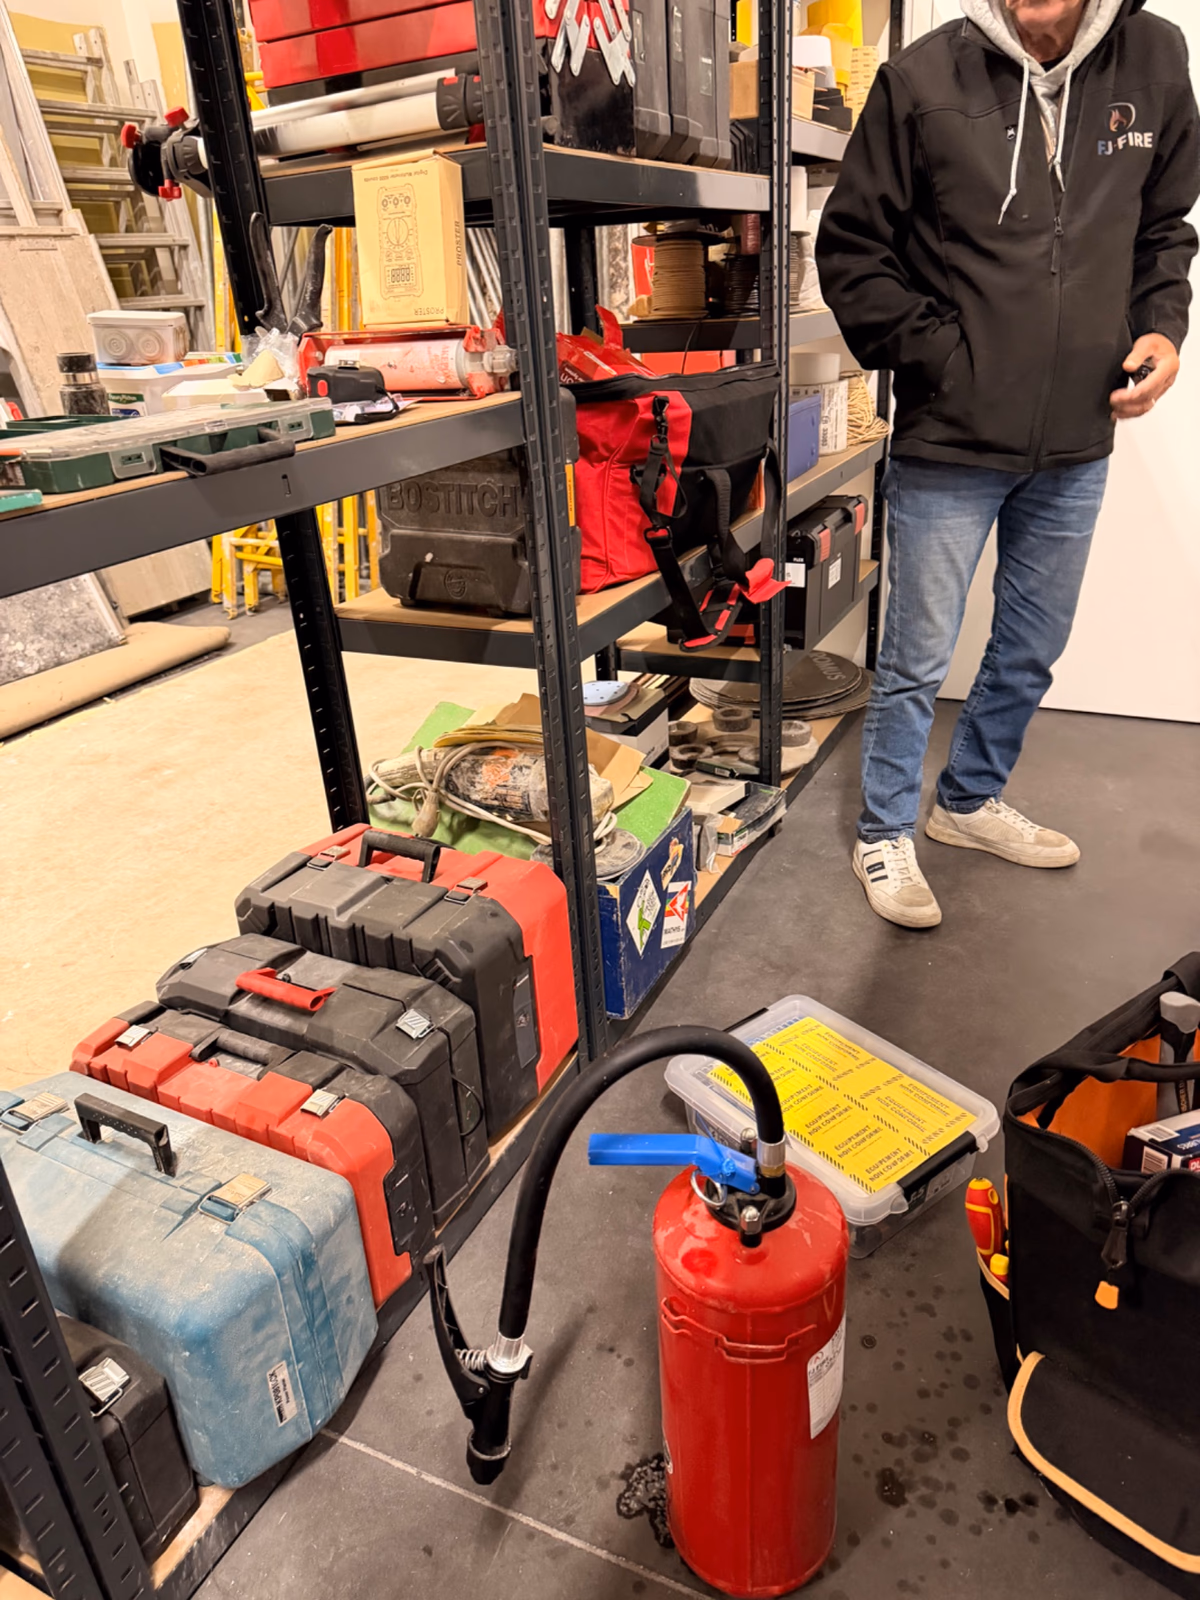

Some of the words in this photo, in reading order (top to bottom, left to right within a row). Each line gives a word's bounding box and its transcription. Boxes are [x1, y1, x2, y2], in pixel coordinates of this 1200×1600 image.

[454, 220, 463, 266] PROSTER
[413, 307, 445, 317] PROSTER
[387, 481, 519, 517] BOSTITCH
[899, 1083, 914, 1094] NON
[913, 1090, 950, 1117] CONFORME
[876, 1096, 891, 1106] NON
[890, 1104, 927, 1133] CONFORME
[807, 1125, 823, 1137] NON
[837, 1147, 853, 1159] NON
[868, 1170, 884, 1183] NON
